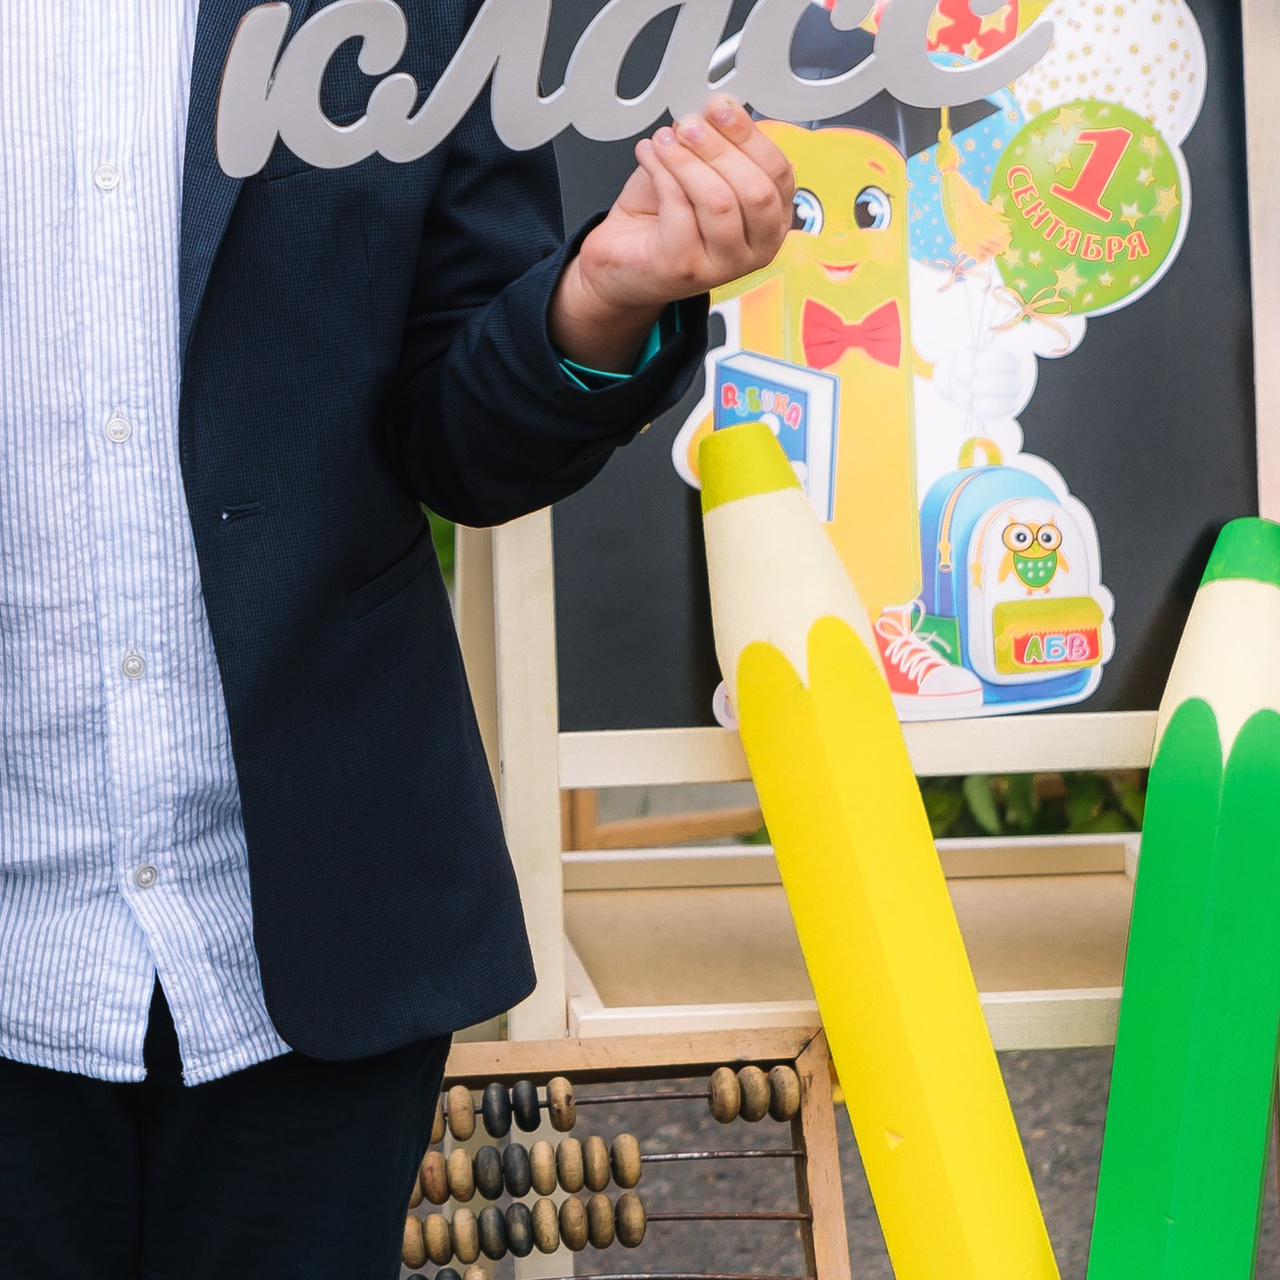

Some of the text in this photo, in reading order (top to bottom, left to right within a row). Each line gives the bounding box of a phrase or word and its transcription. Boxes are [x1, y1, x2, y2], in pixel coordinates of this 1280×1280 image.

[1049, 126, 1133, 222] 1
[1006, 164, 1150, 262] СЕНТЯБРЯ
[721, 383, 802, 430] АЗБУКА
[1023, 633, 1090, 663] АБВ
